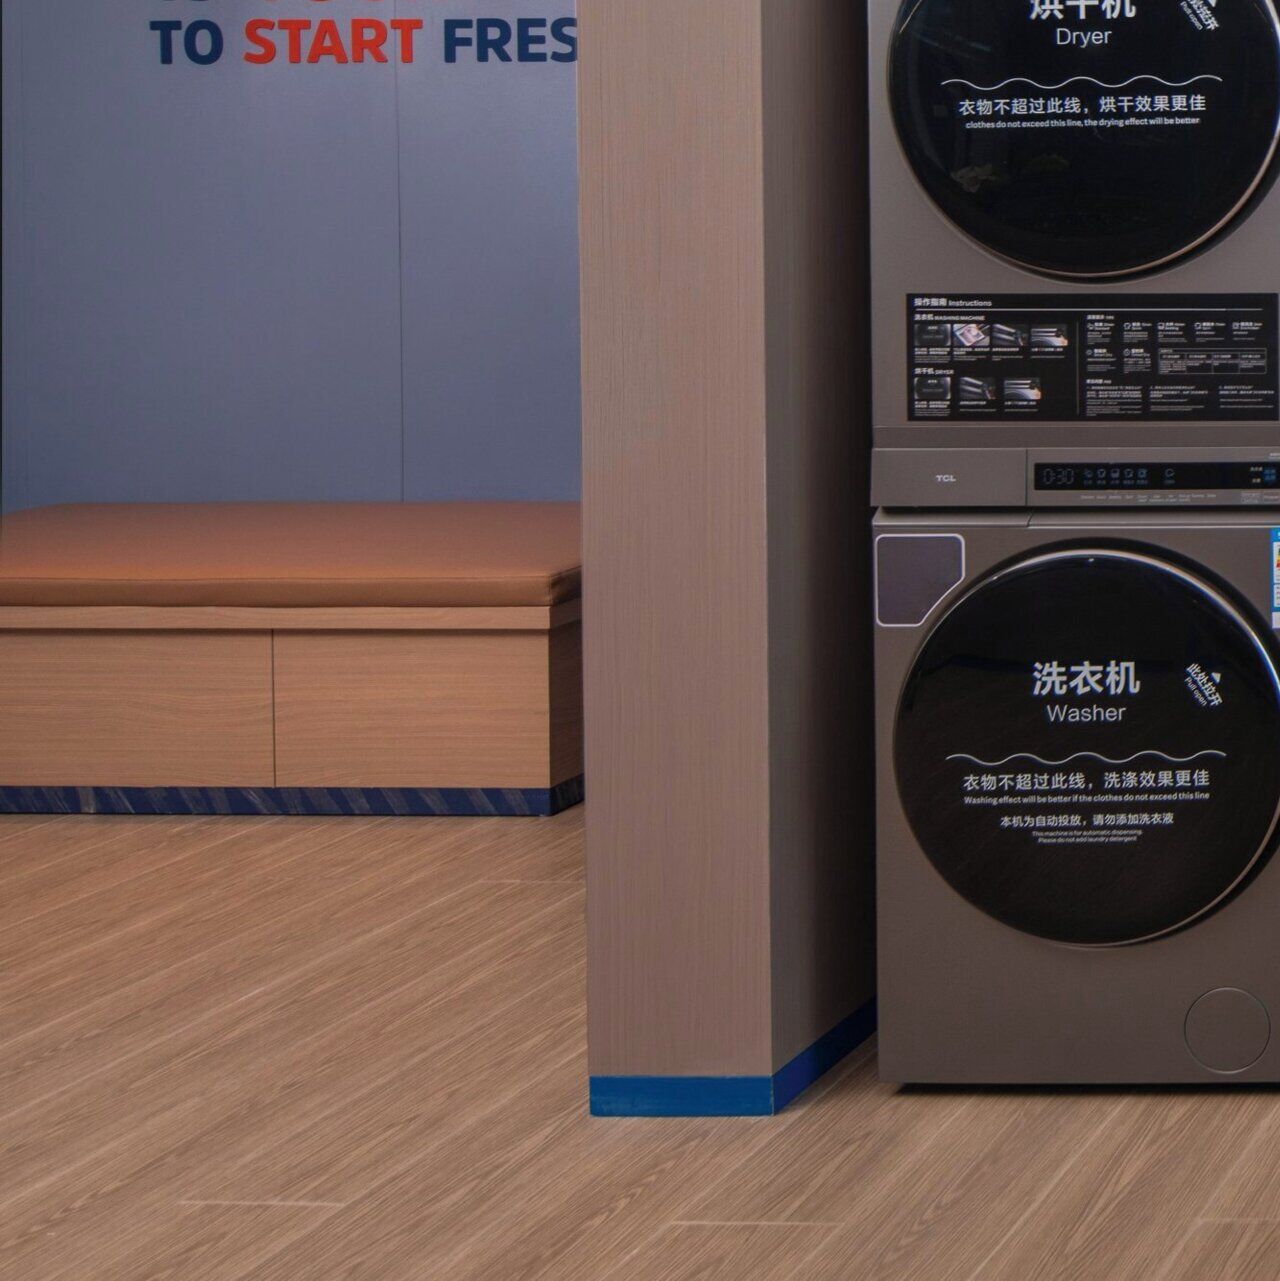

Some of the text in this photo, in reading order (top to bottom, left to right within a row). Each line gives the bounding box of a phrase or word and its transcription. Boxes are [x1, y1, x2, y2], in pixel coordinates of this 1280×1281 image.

[1180, 1, 1191, 14] Pull
[150, 19, 224, 65] TO
[243, 18, 422, 64] START
[1056, 27, 1113, 49] Dryer
[958, 94, 1207, 116] 衣物不超过此线，烘干效果更佳
[948, 299, 992, 307] Instructions
[935, 474, 956, 482] TCL
[1032, 659, 1141, 696] 洗衣机
[1184, 676, 1196, 690] Pull
[1186, 663, 1222, 705] 此处拉开
[1046, 704, 1127, 722] Washer
[963, 769, 1210, 791] 衣物不超过此线，洗涤效果更佳
